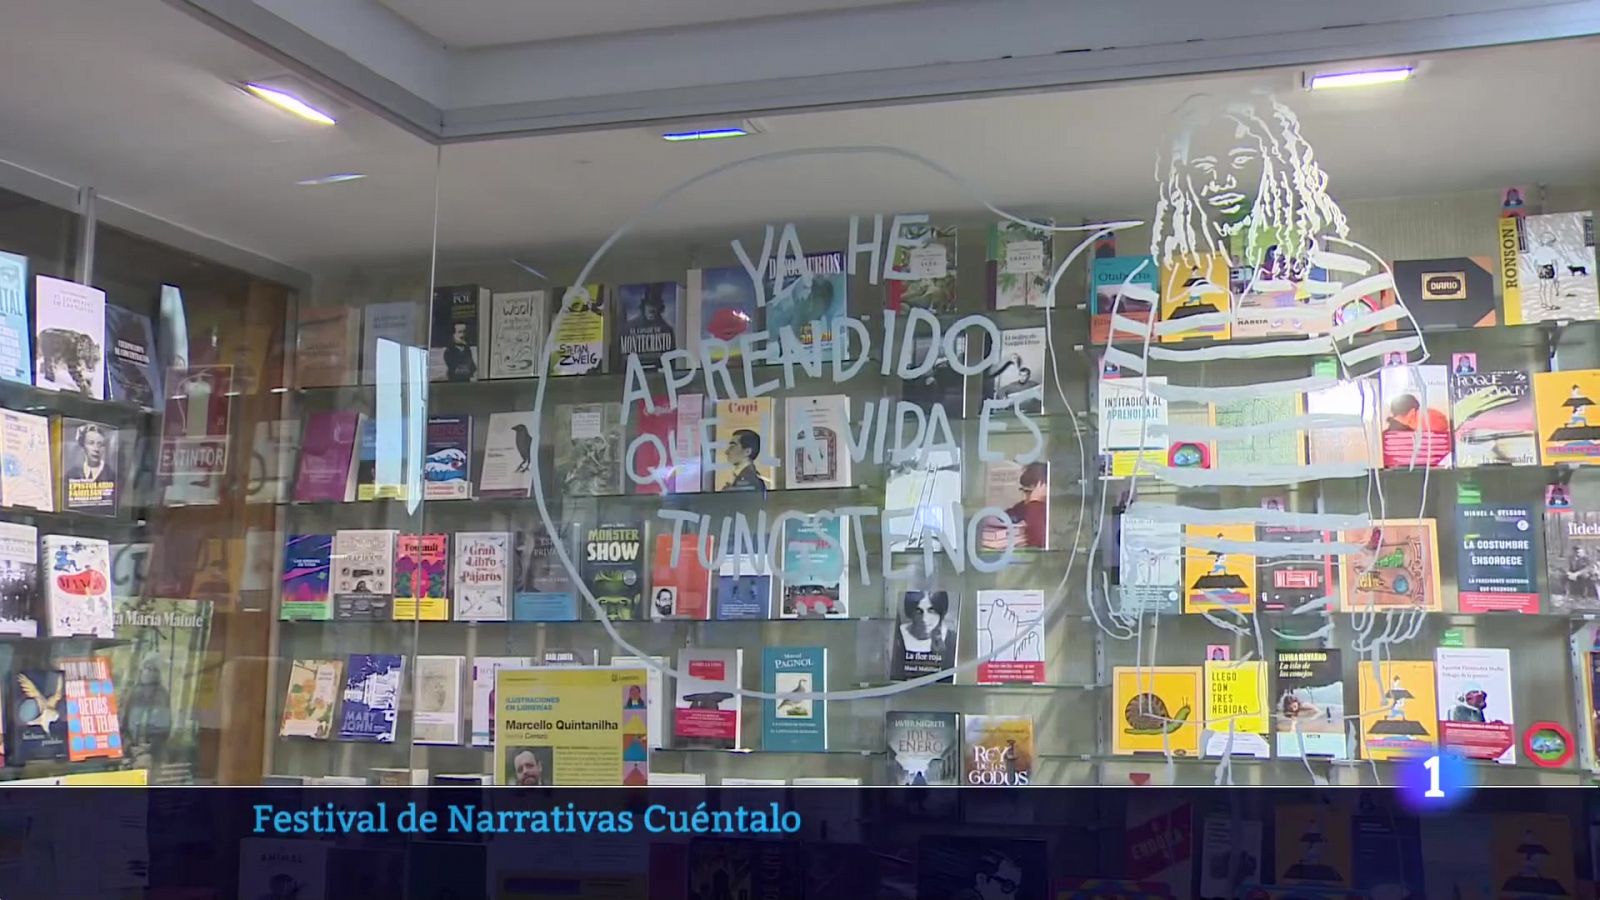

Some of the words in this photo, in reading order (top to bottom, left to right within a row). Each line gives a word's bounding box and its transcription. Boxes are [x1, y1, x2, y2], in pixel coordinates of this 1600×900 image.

[731, 223, 806, 307] YA
[847, 213, 929, 285] HE
[1502, 228, 1518, 289] RONSON
[1430, 281, 1458, 291] DIARIO
[620, 332, 672, 354] MONTECRISTO
[728, 401, 758, 415] Copi
[625, 416, 733, 496] QUE
[760, 404, 826, 476] LA
[843, 397, 960, 470] VIDA
[978, 398, 1043, 466] ES
[161, 446, 224, 468] EXTINTOR
[588, 528, 640, 541] MONSTER
[469, 544, 496, 556] Gran
[1463, 540, 1475, 550] LA
[1477, 540, 1529, 550] COSTUMBRE
[587, 541, 640, 562] SHOW
[465, 556, 497, 567] Libro
[1471, 556, 1523, 566] ENSORDECE
[905, 652, 914, 661] La
[915, 652, 928, 661] flor
[929, 653, 942, 663] roja
[774, 658, 813, 669] PAGNOL
[1212, 683, 1228, 693] CON
[1212, 694, 1233, 703] TRES
[1212, 704, 1248, 714] HERIDAS
[341, 720, 374, 732] JOHN
[505, 720, 553, 730] Marcello
[556, 720, 619, 731] Quintanilha
